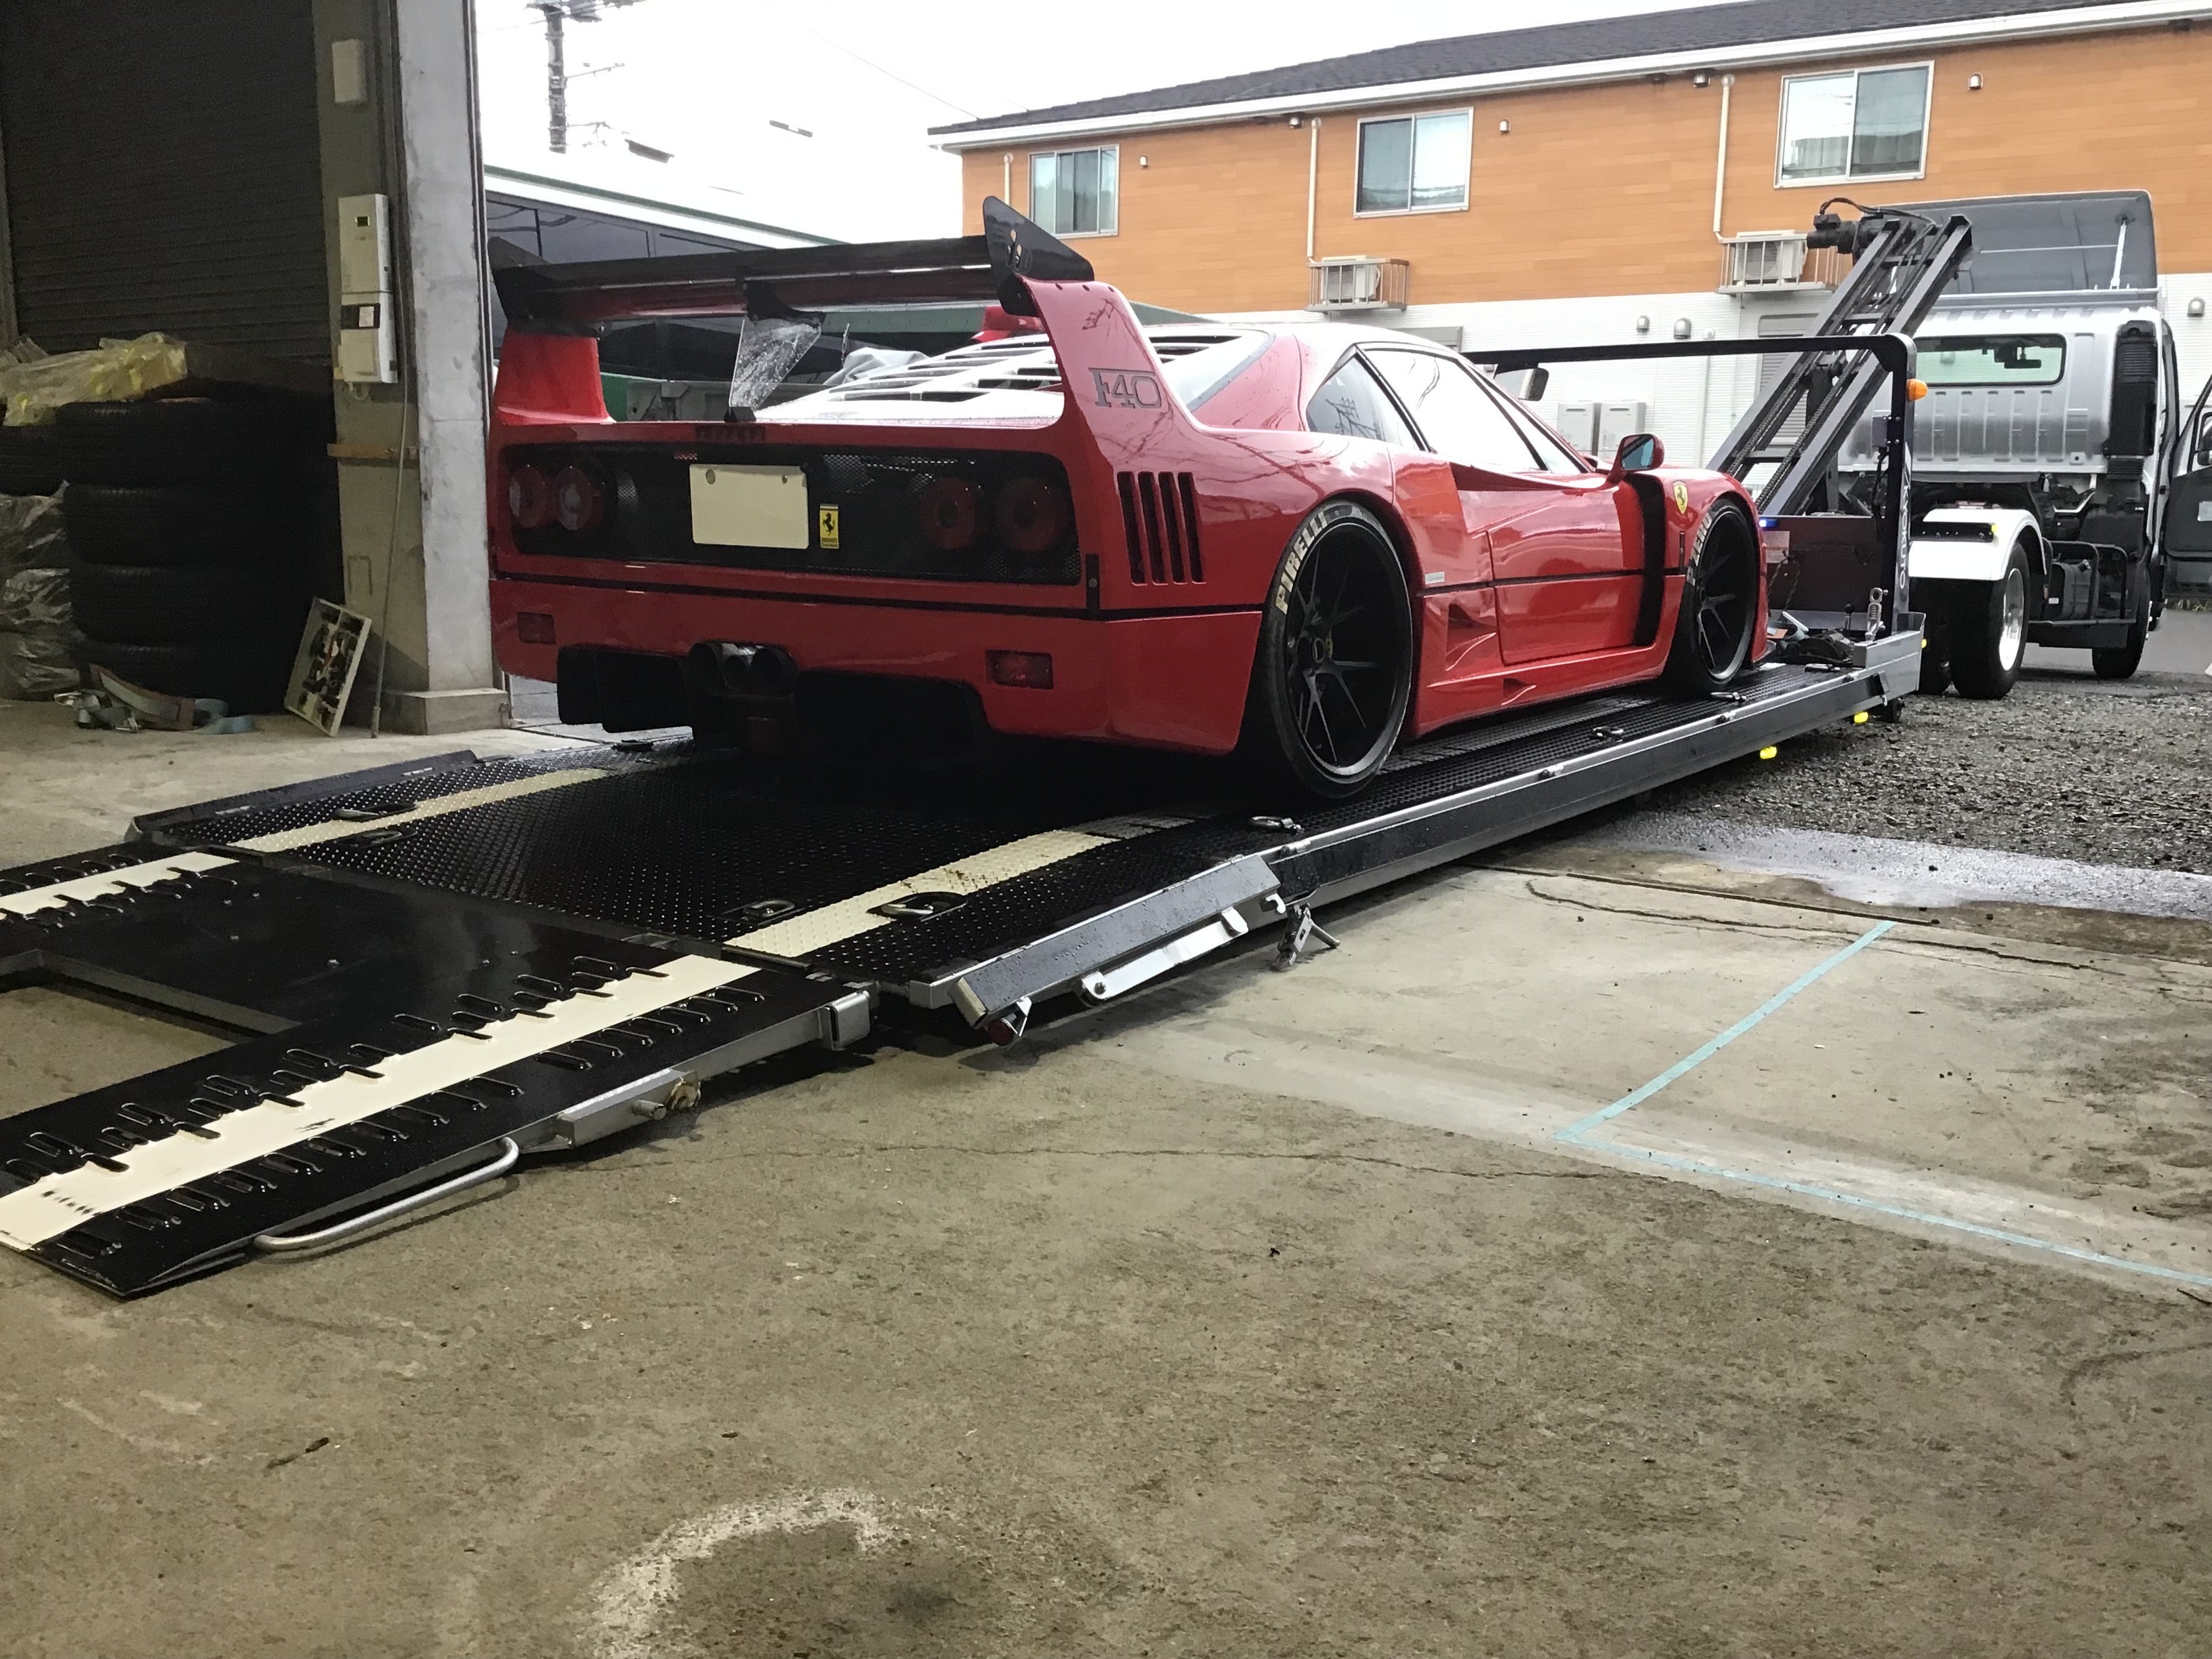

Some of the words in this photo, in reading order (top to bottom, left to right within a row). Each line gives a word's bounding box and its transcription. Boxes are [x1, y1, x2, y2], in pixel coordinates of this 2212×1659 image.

[1088, 367, 1162, 409] F40
[1275, 511, 1328, 615] PIRELLI
[1900, 485, 1909, 590] KYOKUTO
